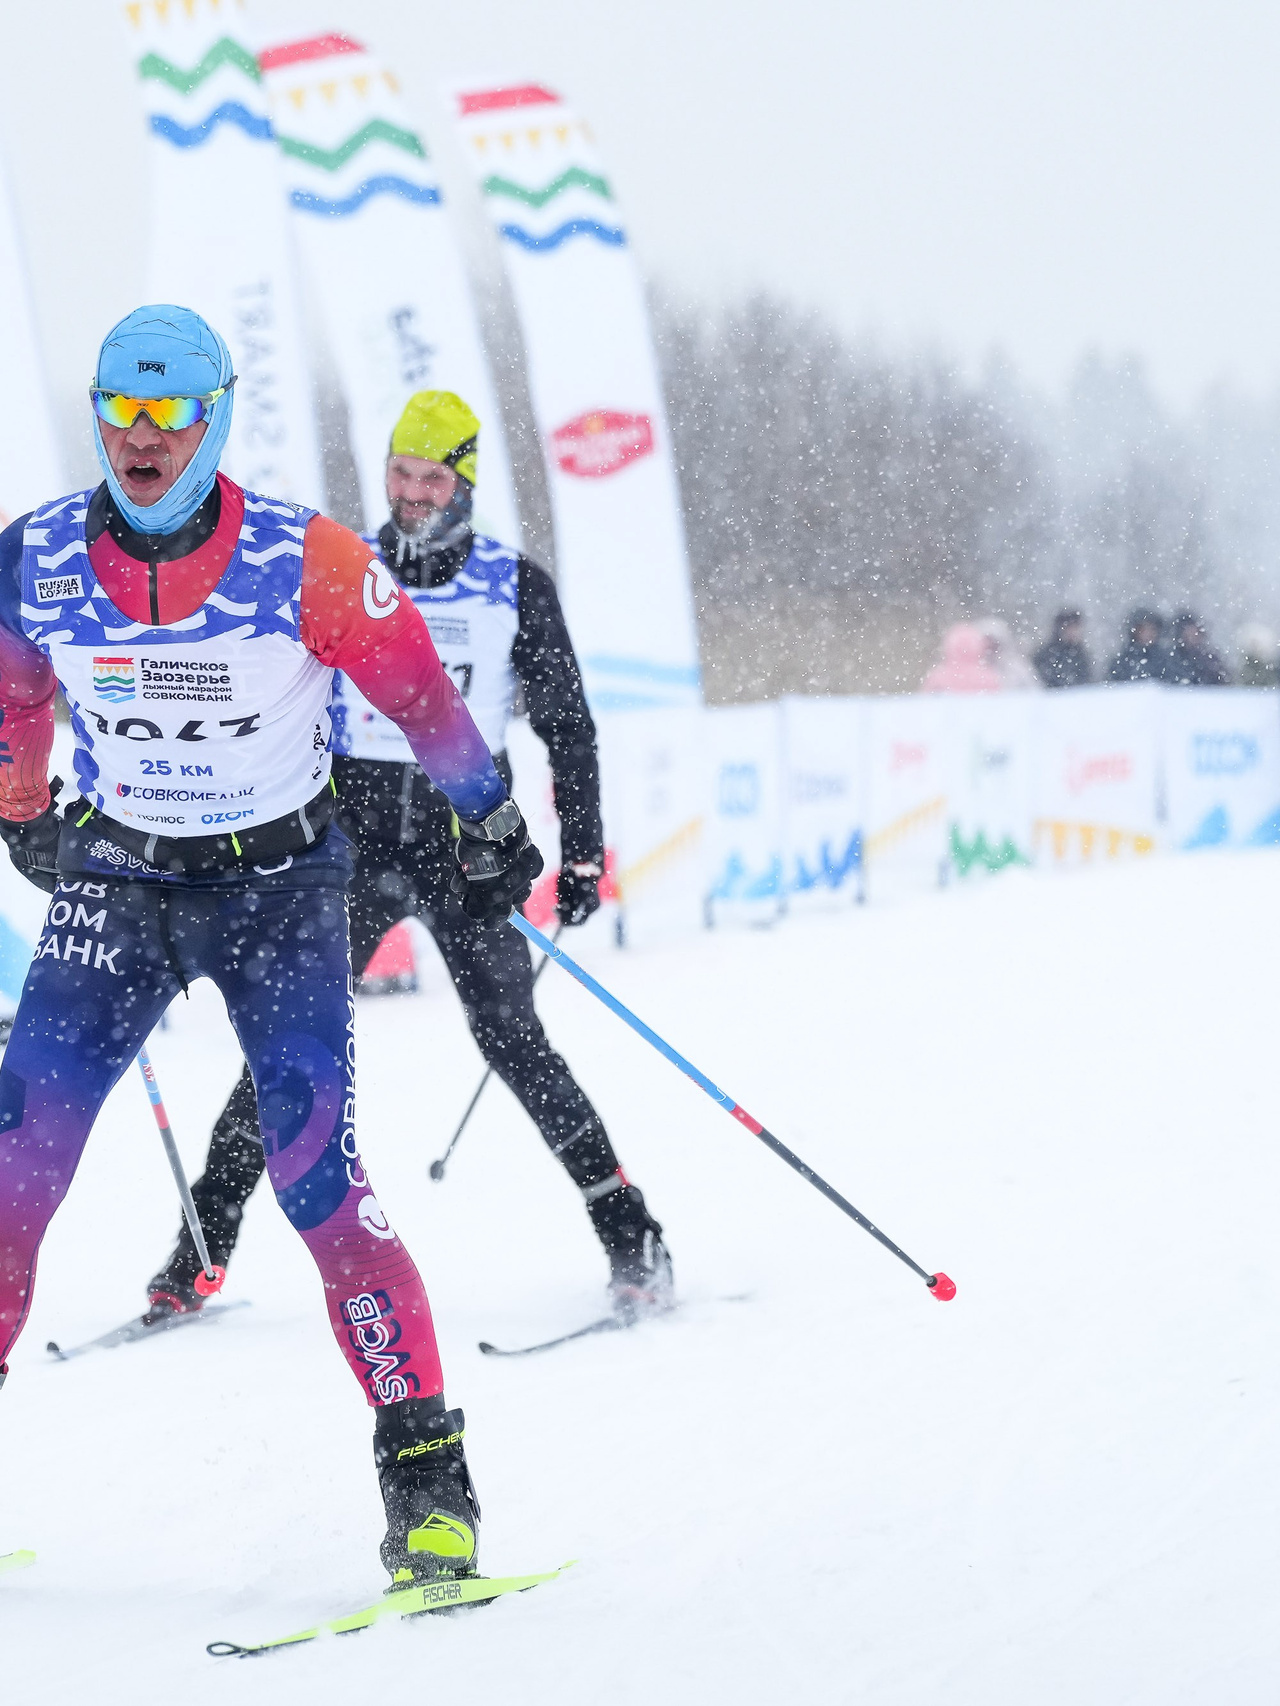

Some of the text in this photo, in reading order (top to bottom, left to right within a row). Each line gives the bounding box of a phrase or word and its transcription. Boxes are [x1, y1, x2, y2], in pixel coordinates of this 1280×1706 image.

[38, 577, 79, 591] RUSSIA
[39, 586, 79, 599] LOPPET
[140, 658, 228, 672] Галичское
[141, 670, 231, 686] Заозерье
[142, 684, 232, 693] лыжный марафон
[142, 691, 233, 702] СОВКОМБАНК
[139, 759, 173, 776] 25
[200, 808, 255, 825] OZON
[55, 881, 108, 899] ОВ
[346, 1292, 408, 1405] SVCB
[422, 1583, 463, 1606] FISCHER
